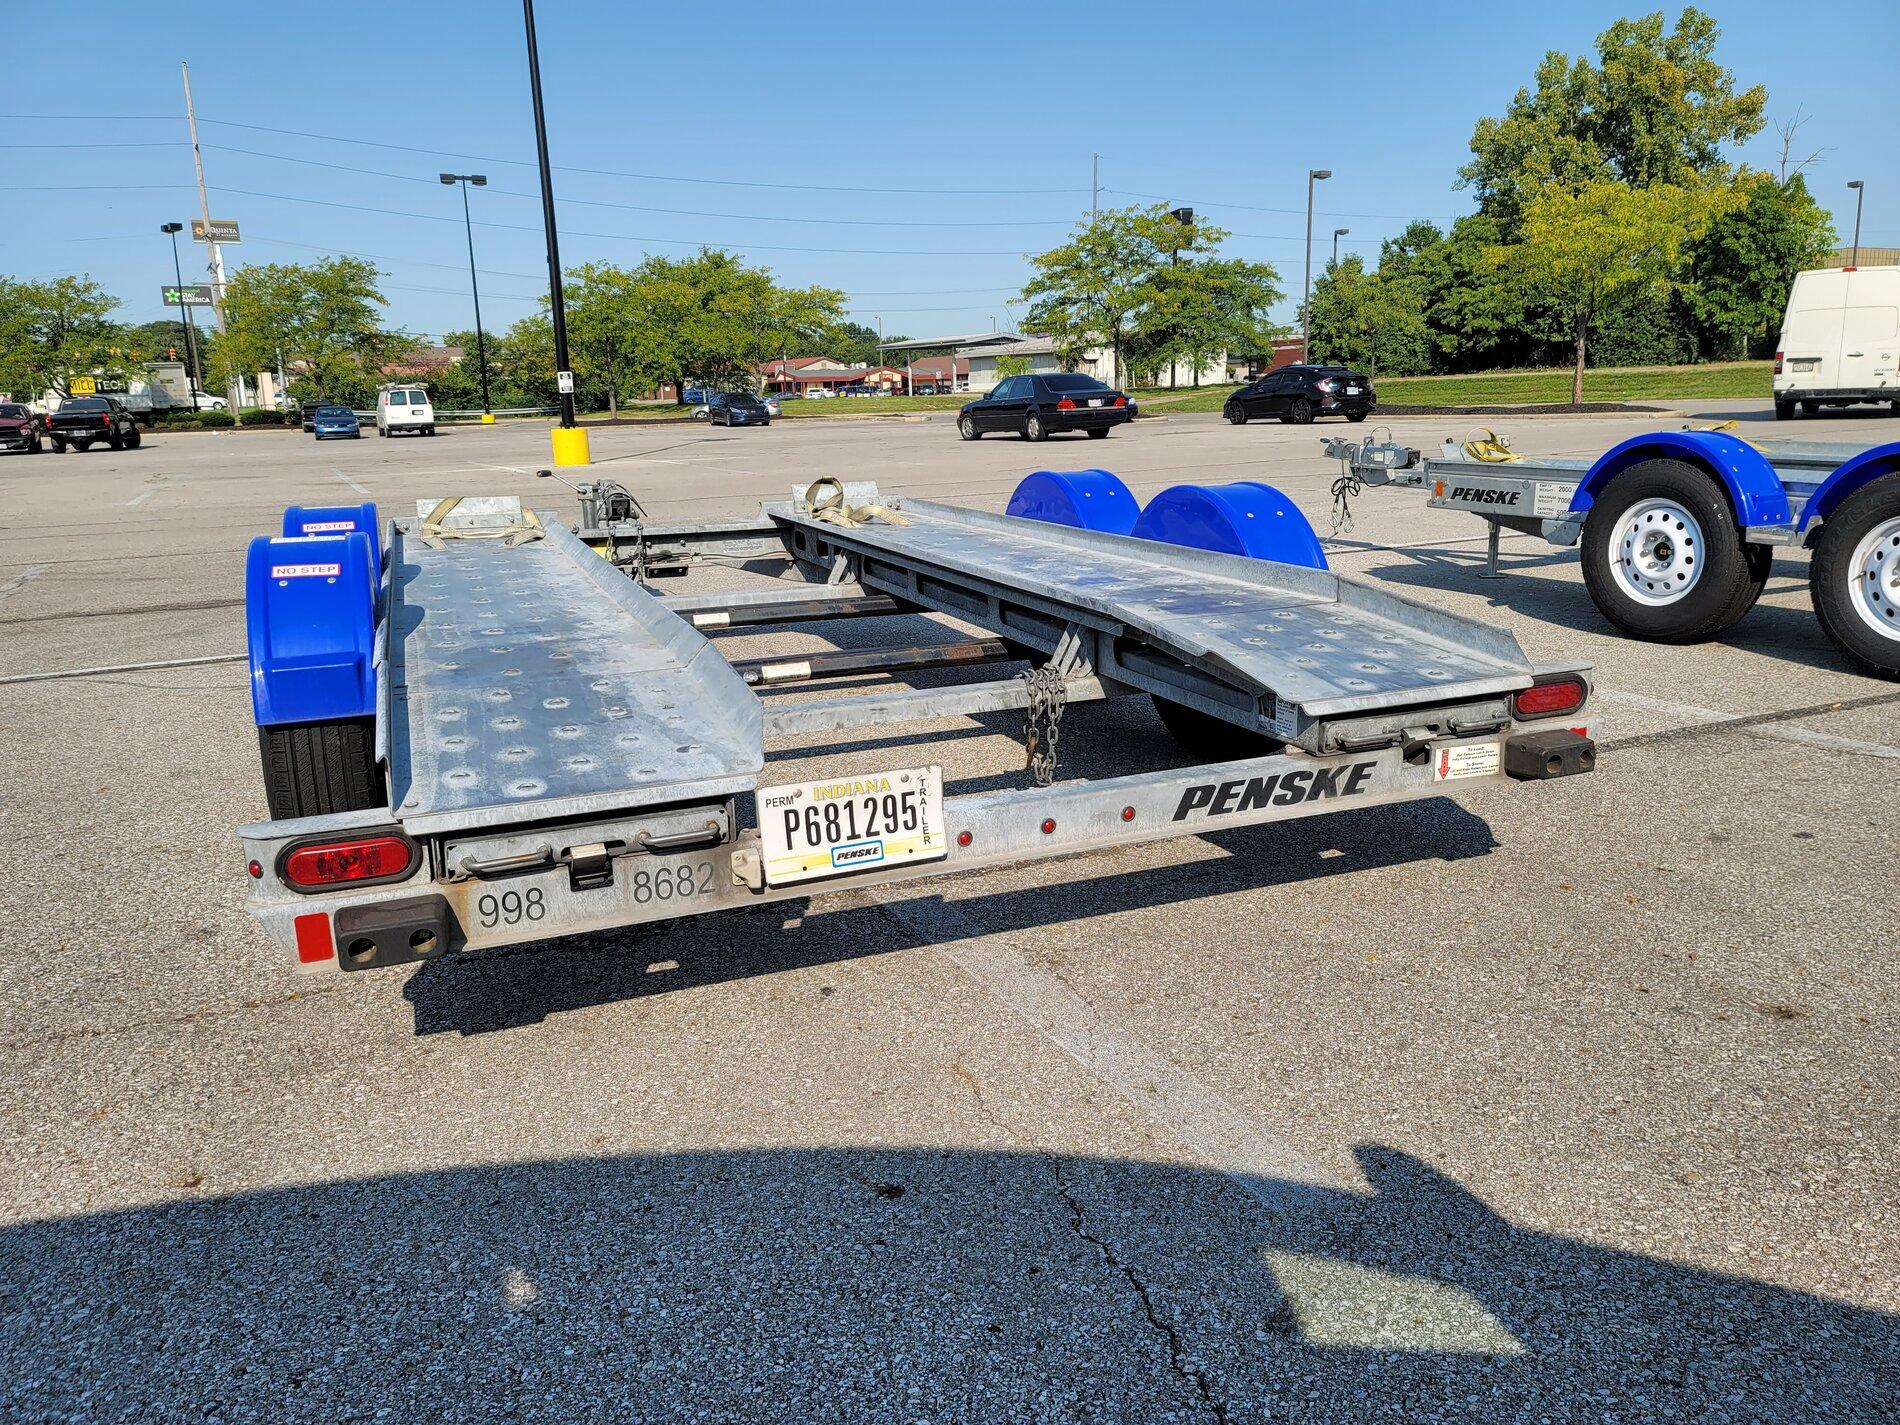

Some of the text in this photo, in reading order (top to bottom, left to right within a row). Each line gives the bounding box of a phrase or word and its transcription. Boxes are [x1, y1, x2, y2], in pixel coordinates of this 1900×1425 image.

[96, 379, 126, 391] TECH
[1450, 487, 1521, 506] PENSKE
[276, 566, 336, 575] NO STEP
[813, 777, 892, 801] INDIANA
[1171, 761, 1377, 822] PENSKE
[765, 795, 794, 808] PERM
[918, 778, 932, 845] TRAILER
[783, 791, 918, 851] P681295
[836, 846, 880, 861] PENSKE
[633, 861, 716, 903] 8682
[478, 887, 546, 929] 998
